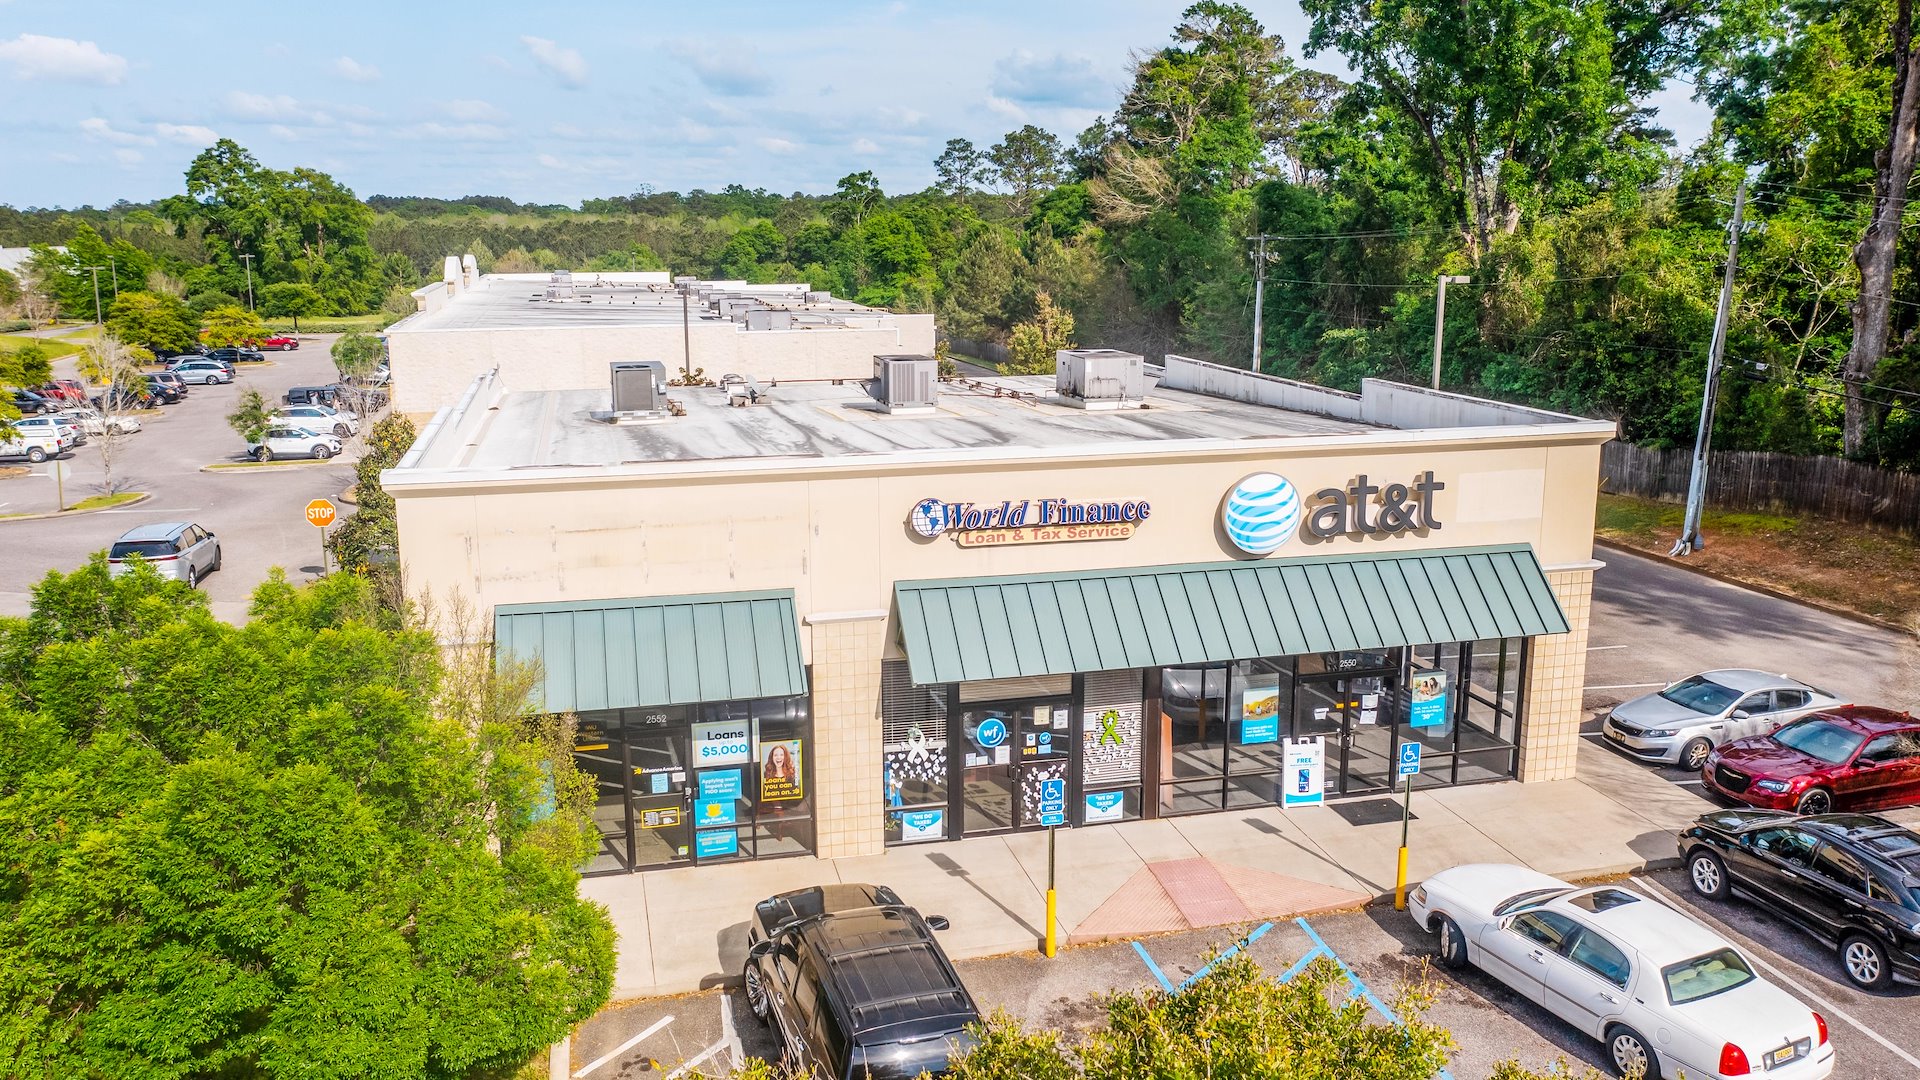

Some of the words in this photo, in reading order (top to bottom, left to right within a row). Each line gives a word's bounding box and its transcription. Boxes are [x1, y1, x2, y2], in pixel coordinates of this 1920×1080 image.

[1307, 470, 1444, 538] at&t
[308, 507, 334, 519] STOP
[941, 499, 1030, 531] World
[1038, 497, 1151, 526] Finance
[964, 532, 1006, 545] Loan
[1012, 530, 1024, 542] &
[1031, 528, 1061, 541] Tax
[1066, 524, 1130, 539] Service
[1340, 659, 1357, 668] 2550
[645, 714, 667, 724] 2552
[707, 730, 744, 741] Loans
[983, 725, 999, 738] wf
[702, 743, 748, 758] $5,000
